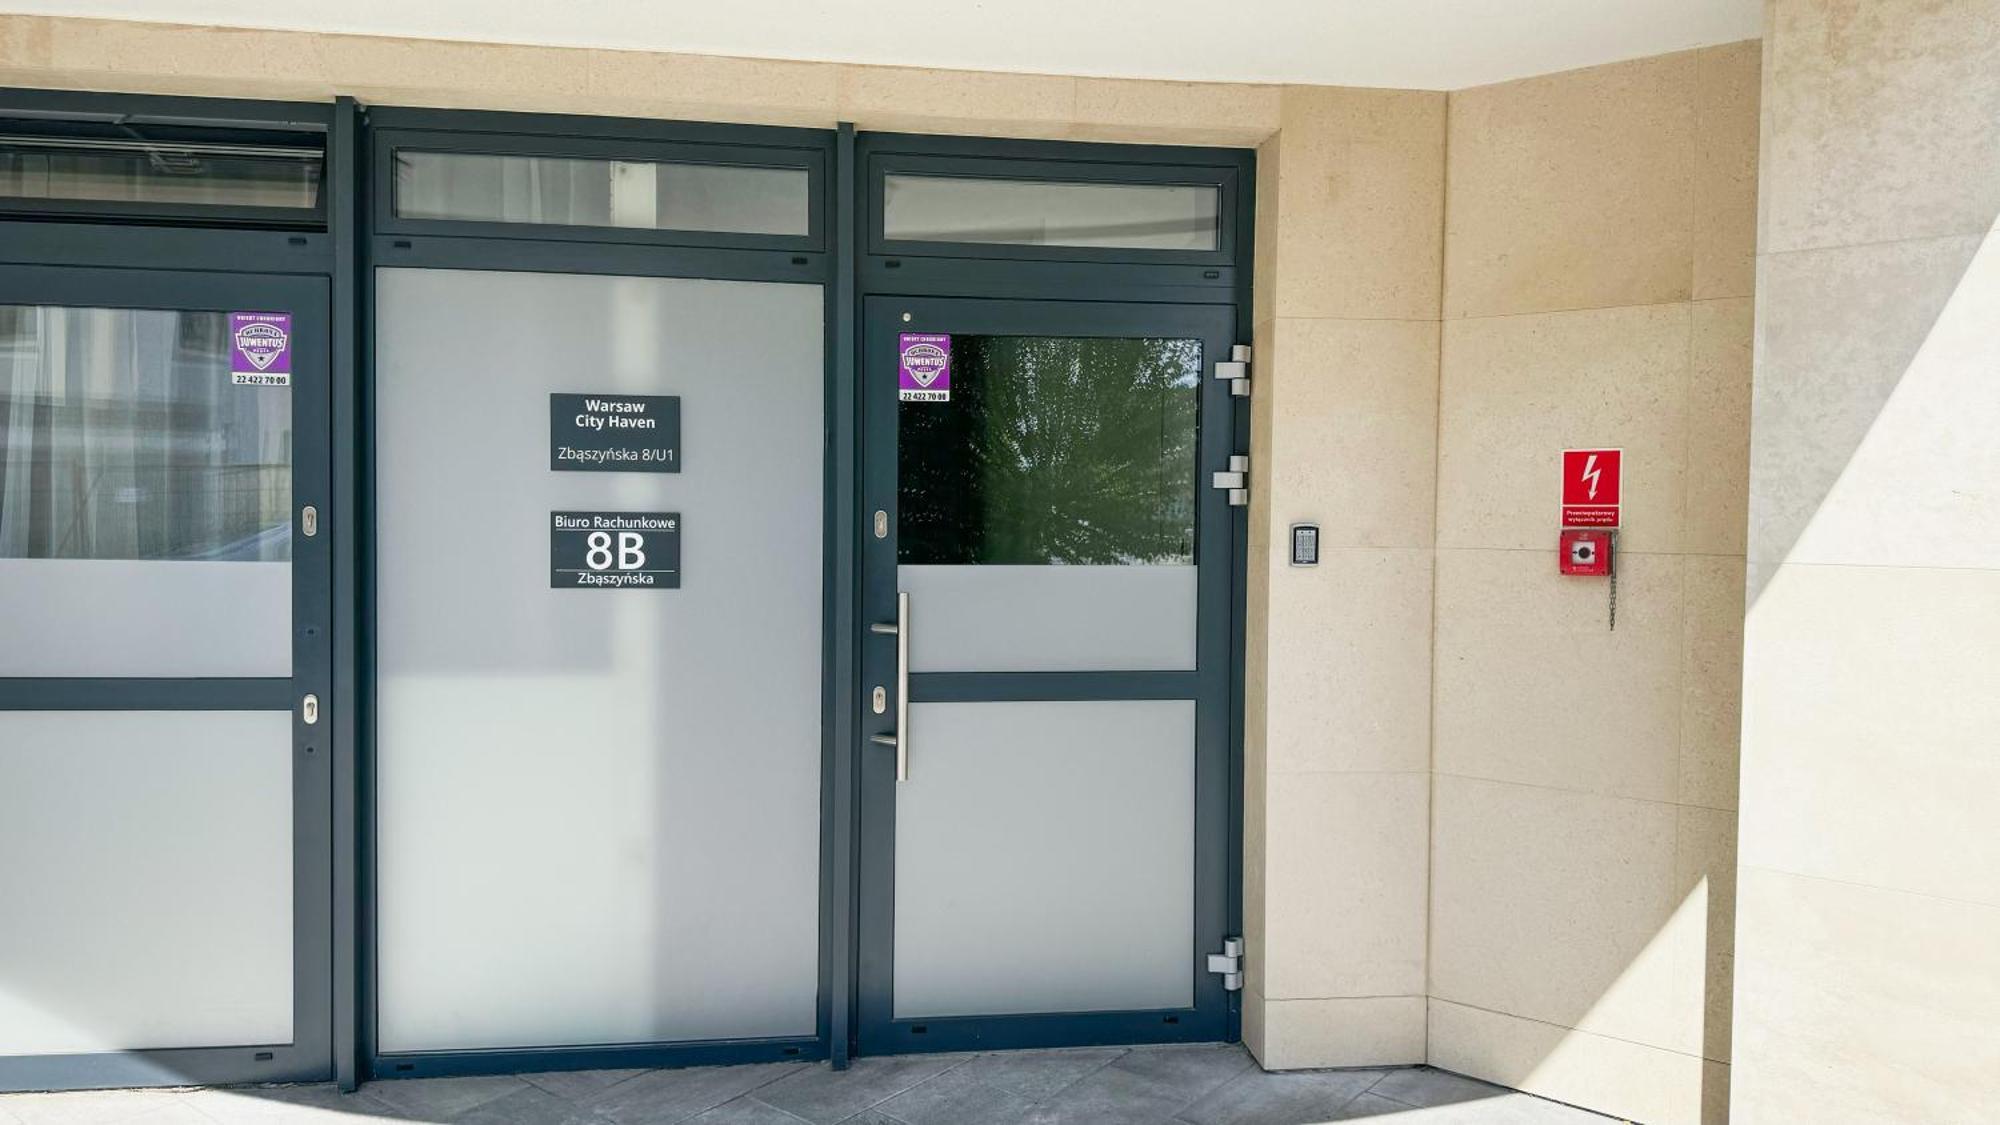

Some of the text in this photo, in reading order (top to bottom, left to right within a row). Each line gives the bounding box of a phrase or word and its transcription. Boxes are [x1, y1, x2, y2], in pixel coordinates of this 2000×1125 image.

[239, 336, 284, 348] JUWENTUS
[236, 375, 246, 384] 22
[248, 375, 263, 384] 422
[903, 392, 912, 400] 22
[913, 392, 926, 400] 422
[927, 392, 936, 400] 70
[585, 399, 645, 413] Warsaw
[575, 415, 656, 431] City Haven
[558, 446, 673, 463] Zbąszyńska 8/U1
[555, 515, 675, 529] Biuro Rachunkowe
[586, 531, 645, 570] 8B
[578, 572, 654, 586] Zbąszyńska
